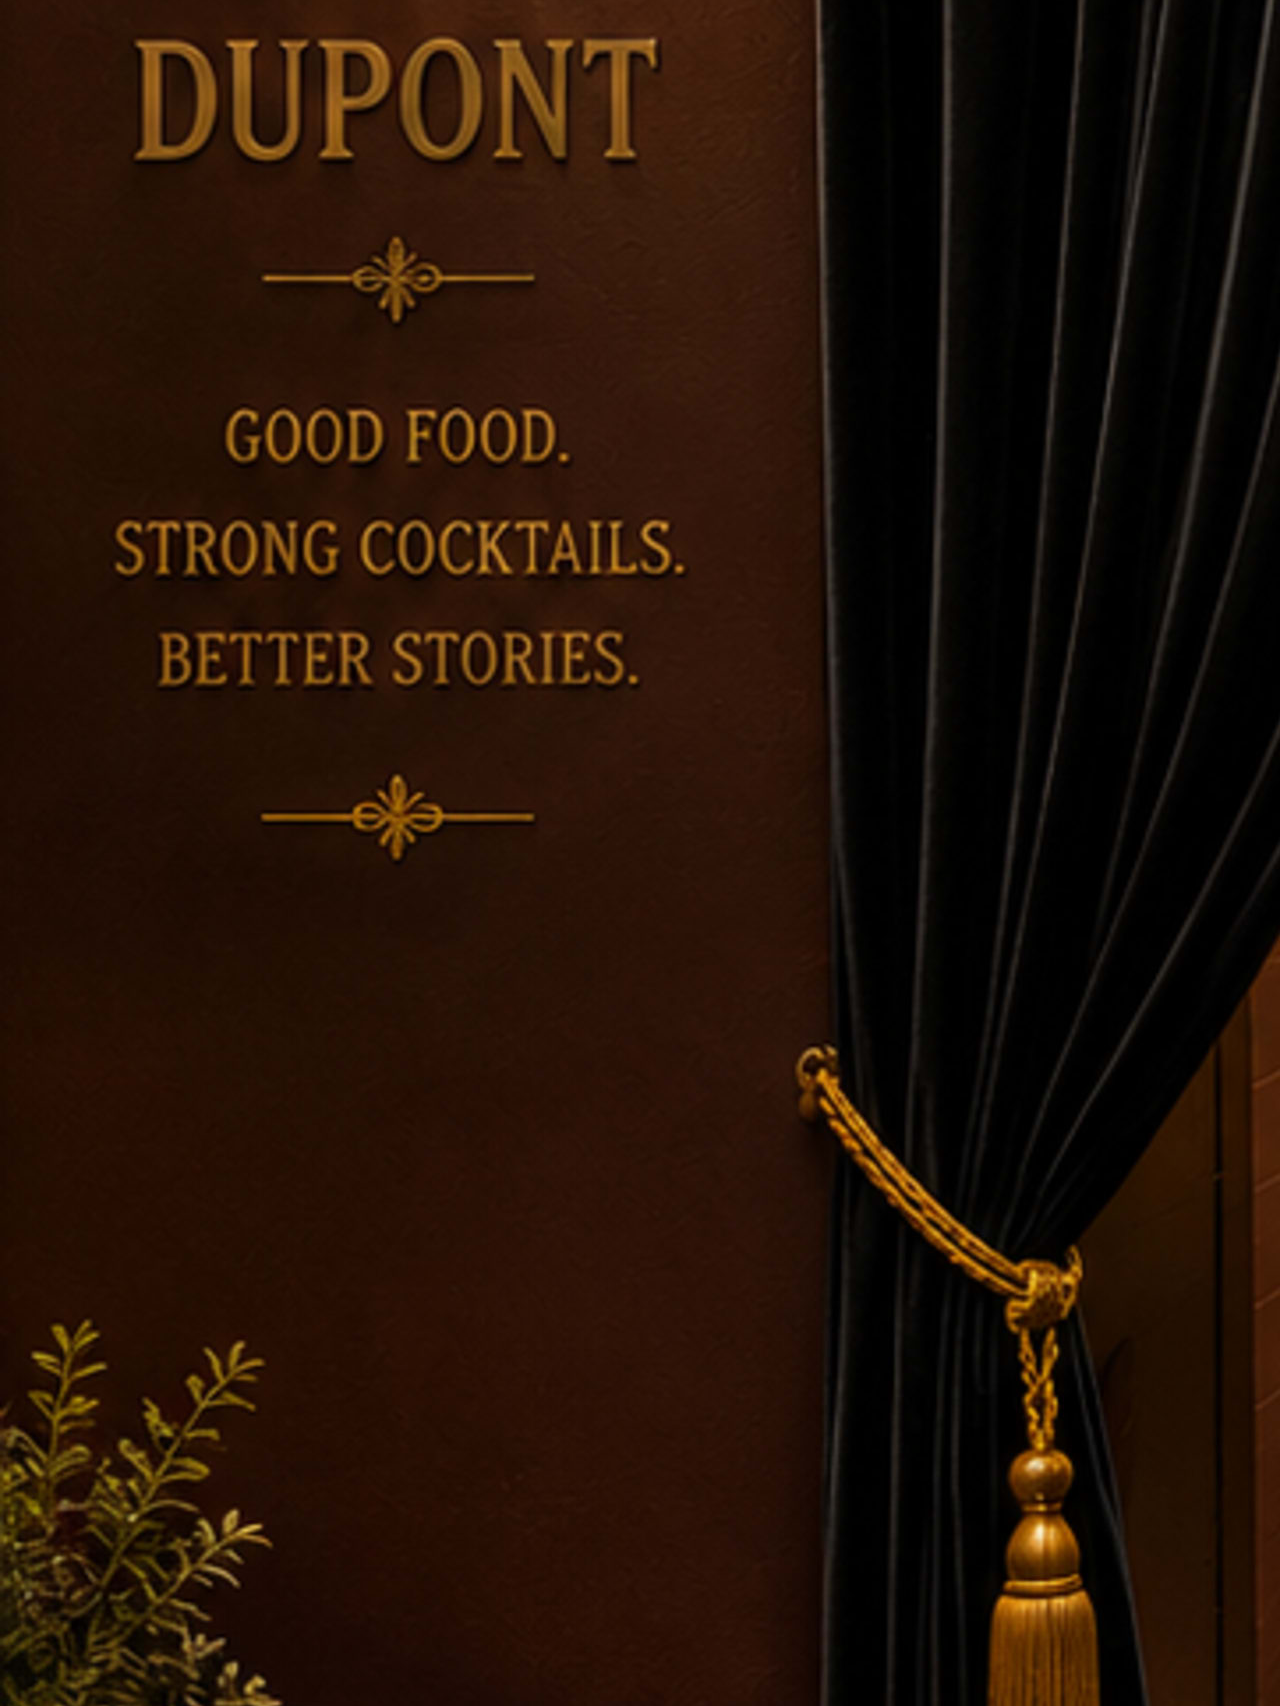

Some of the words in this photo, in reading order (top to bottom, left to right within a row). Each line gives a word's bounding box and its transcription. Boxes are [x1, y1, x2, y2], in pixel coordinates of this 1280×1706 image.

[133, 36, 661, 163] DUPONT
[223, 406, 386, 467] GOOD
[403, 406, 571, 467] FOOD.
[112, 515, 340, 578] STRONG
[359, 515, 687, 578] COCKTAILS.
[156, 629, 376, 689] BETTER
[390, 629, 640, 689] STORIES.
